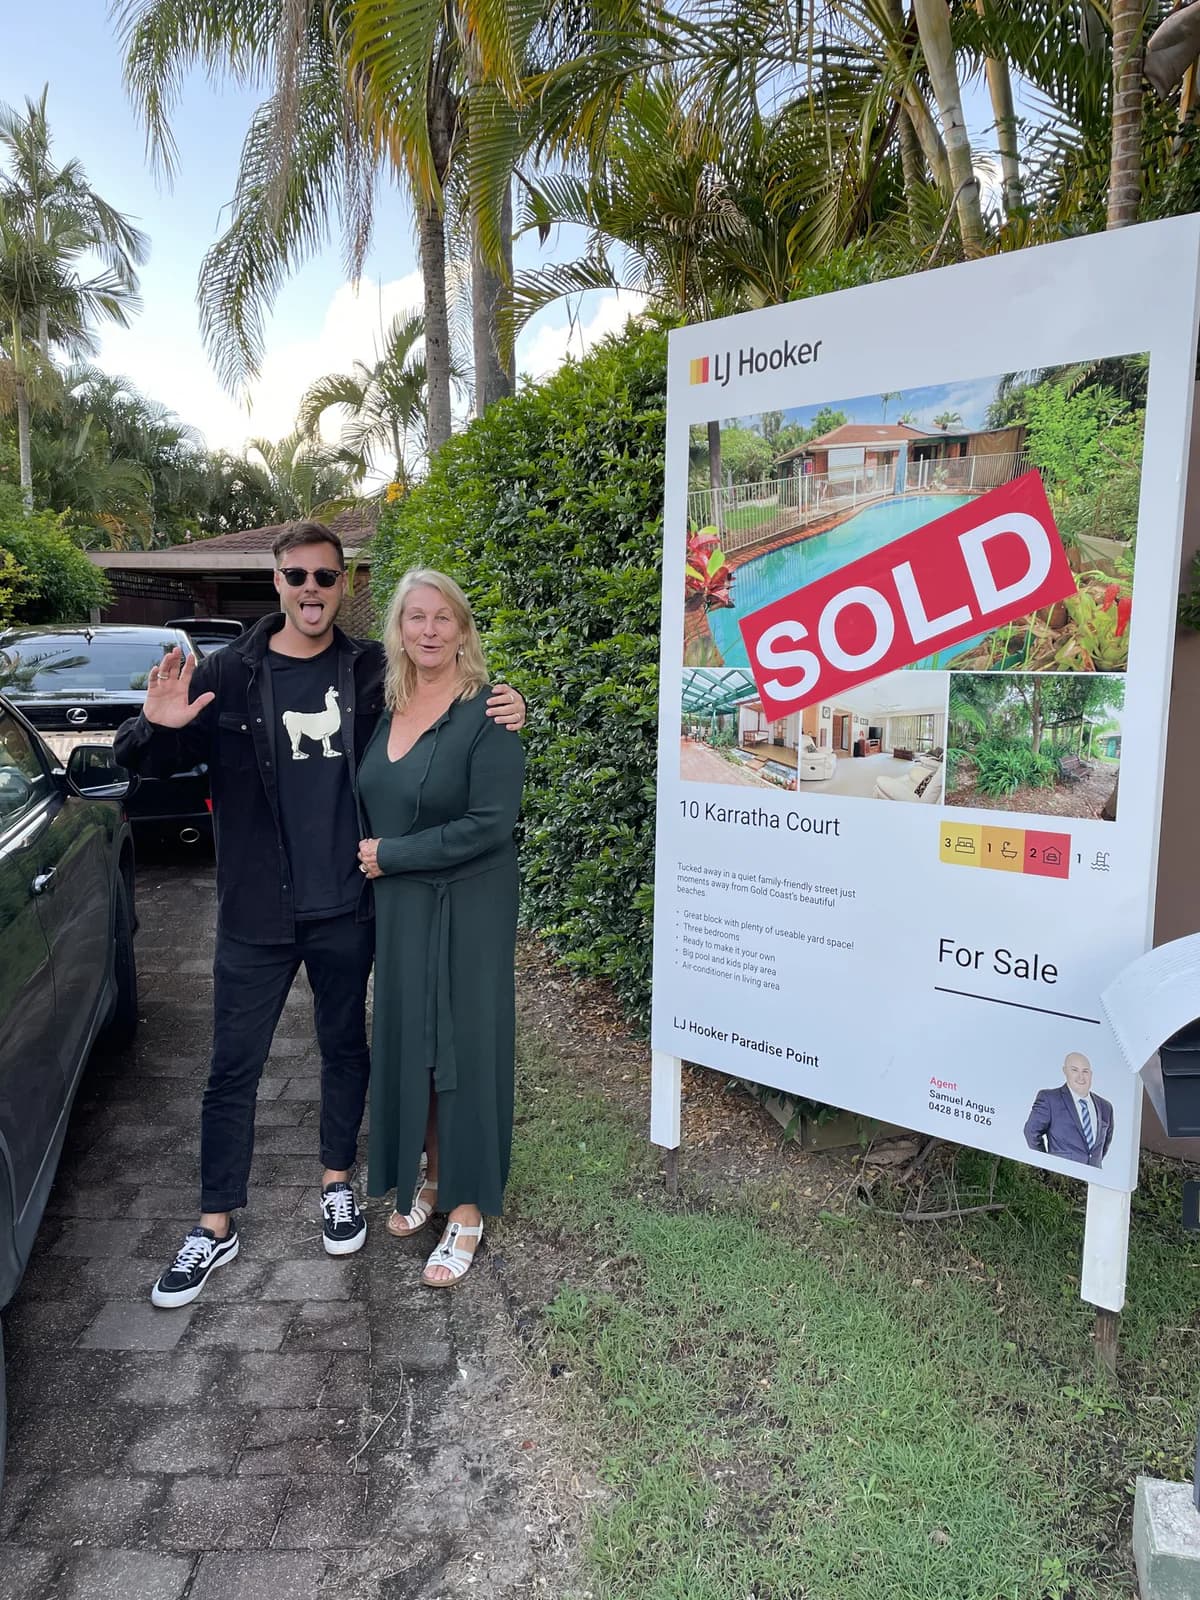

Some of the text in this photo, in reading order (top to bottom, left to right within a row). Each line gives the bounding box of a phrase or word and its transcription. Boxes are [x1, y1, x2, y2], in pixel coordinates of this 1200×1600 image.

[714, 339, 823, 387] LJ Hooker
[755, 512, 1052, 703] SOLD
[679, 800, 841, 836] 10 Karratha Court
[944, 838, 952, 848] 3
[987, 843, 992, 853] 1
[1030, 848, 1037, 858] 2
[1076, 853, 1082, 864] 1
[676, 885, 706, 897] beaches
[677, 862, 702, 874] Tucked
[703, 867, 722, 879] away
[723, 870, 730, 878] in
[737, 873, 757, 883] quiet
[814, 885, 838, 896] street
[839, 888, 856, 899] just
[677, 874, 710, 887] moments
[711, 880, 729, 892] away
[731, 881, 749, 893] from
[750, 886, 768, 896] Gold
[799, 893, 836, 908] beautiful
[683, 910, 855, 950] Great block with plenty of useable yard space!
[683, 922, 740, 942] Three bedrooms
[682, 935, 776, 962] Ready to make it your own
[938, 938, 1058, 984] For Sale
[682, 948, 778, 976] Big pool and kids play area
[733, 972, 741, 981] in
[742, 974, 762, 988] living
[763, 981, 781, 991] area
[673, 1016, 820, 1068] LJ Hooker Paradise Point
[930, 1077, 957, 1091] Agent
[928, 1101, 992, 1126] 0428 818 026
[929, 1089, 996, 1114] Samuel Angus
